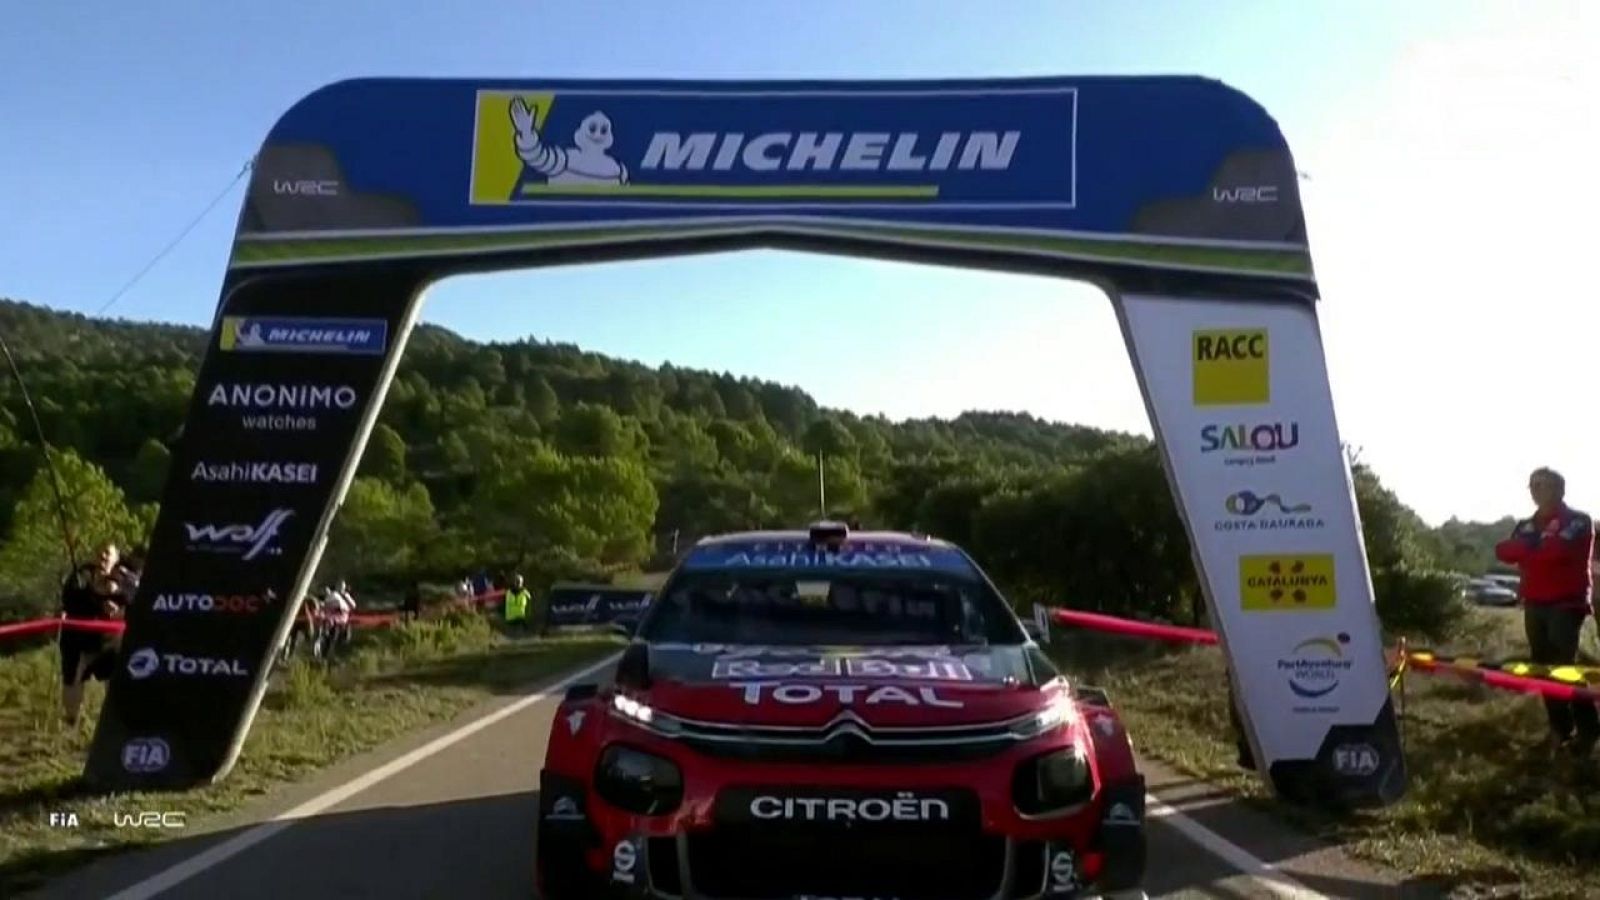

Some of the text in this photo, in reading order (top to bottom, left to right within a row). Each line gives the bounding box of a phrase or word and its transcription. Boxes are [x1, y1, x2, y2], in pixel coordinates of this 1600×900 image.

[640, 130, 1021, 170] MICHELIN
[273, 180, 338, 195] WRC
[1213, 186, 1277, 201] WRC
[267, 328, 371, 343] MICHELIN
[1197, 335, 1264, 360] RACC
[208, 385, 356, 408] ANONIMO
[242, 415, 316, 430] watches
[1201, 422, 1298, 452] SALOU
[191, 462, 317, 483] AsahiKASEI
[1247, 576, 1328, 588] CATALUNYA
[164, 655, 248, 675] TOTAL
[729, 682, 964, 707] TOTAL
[750, 792, 948, 820] CITROËN
